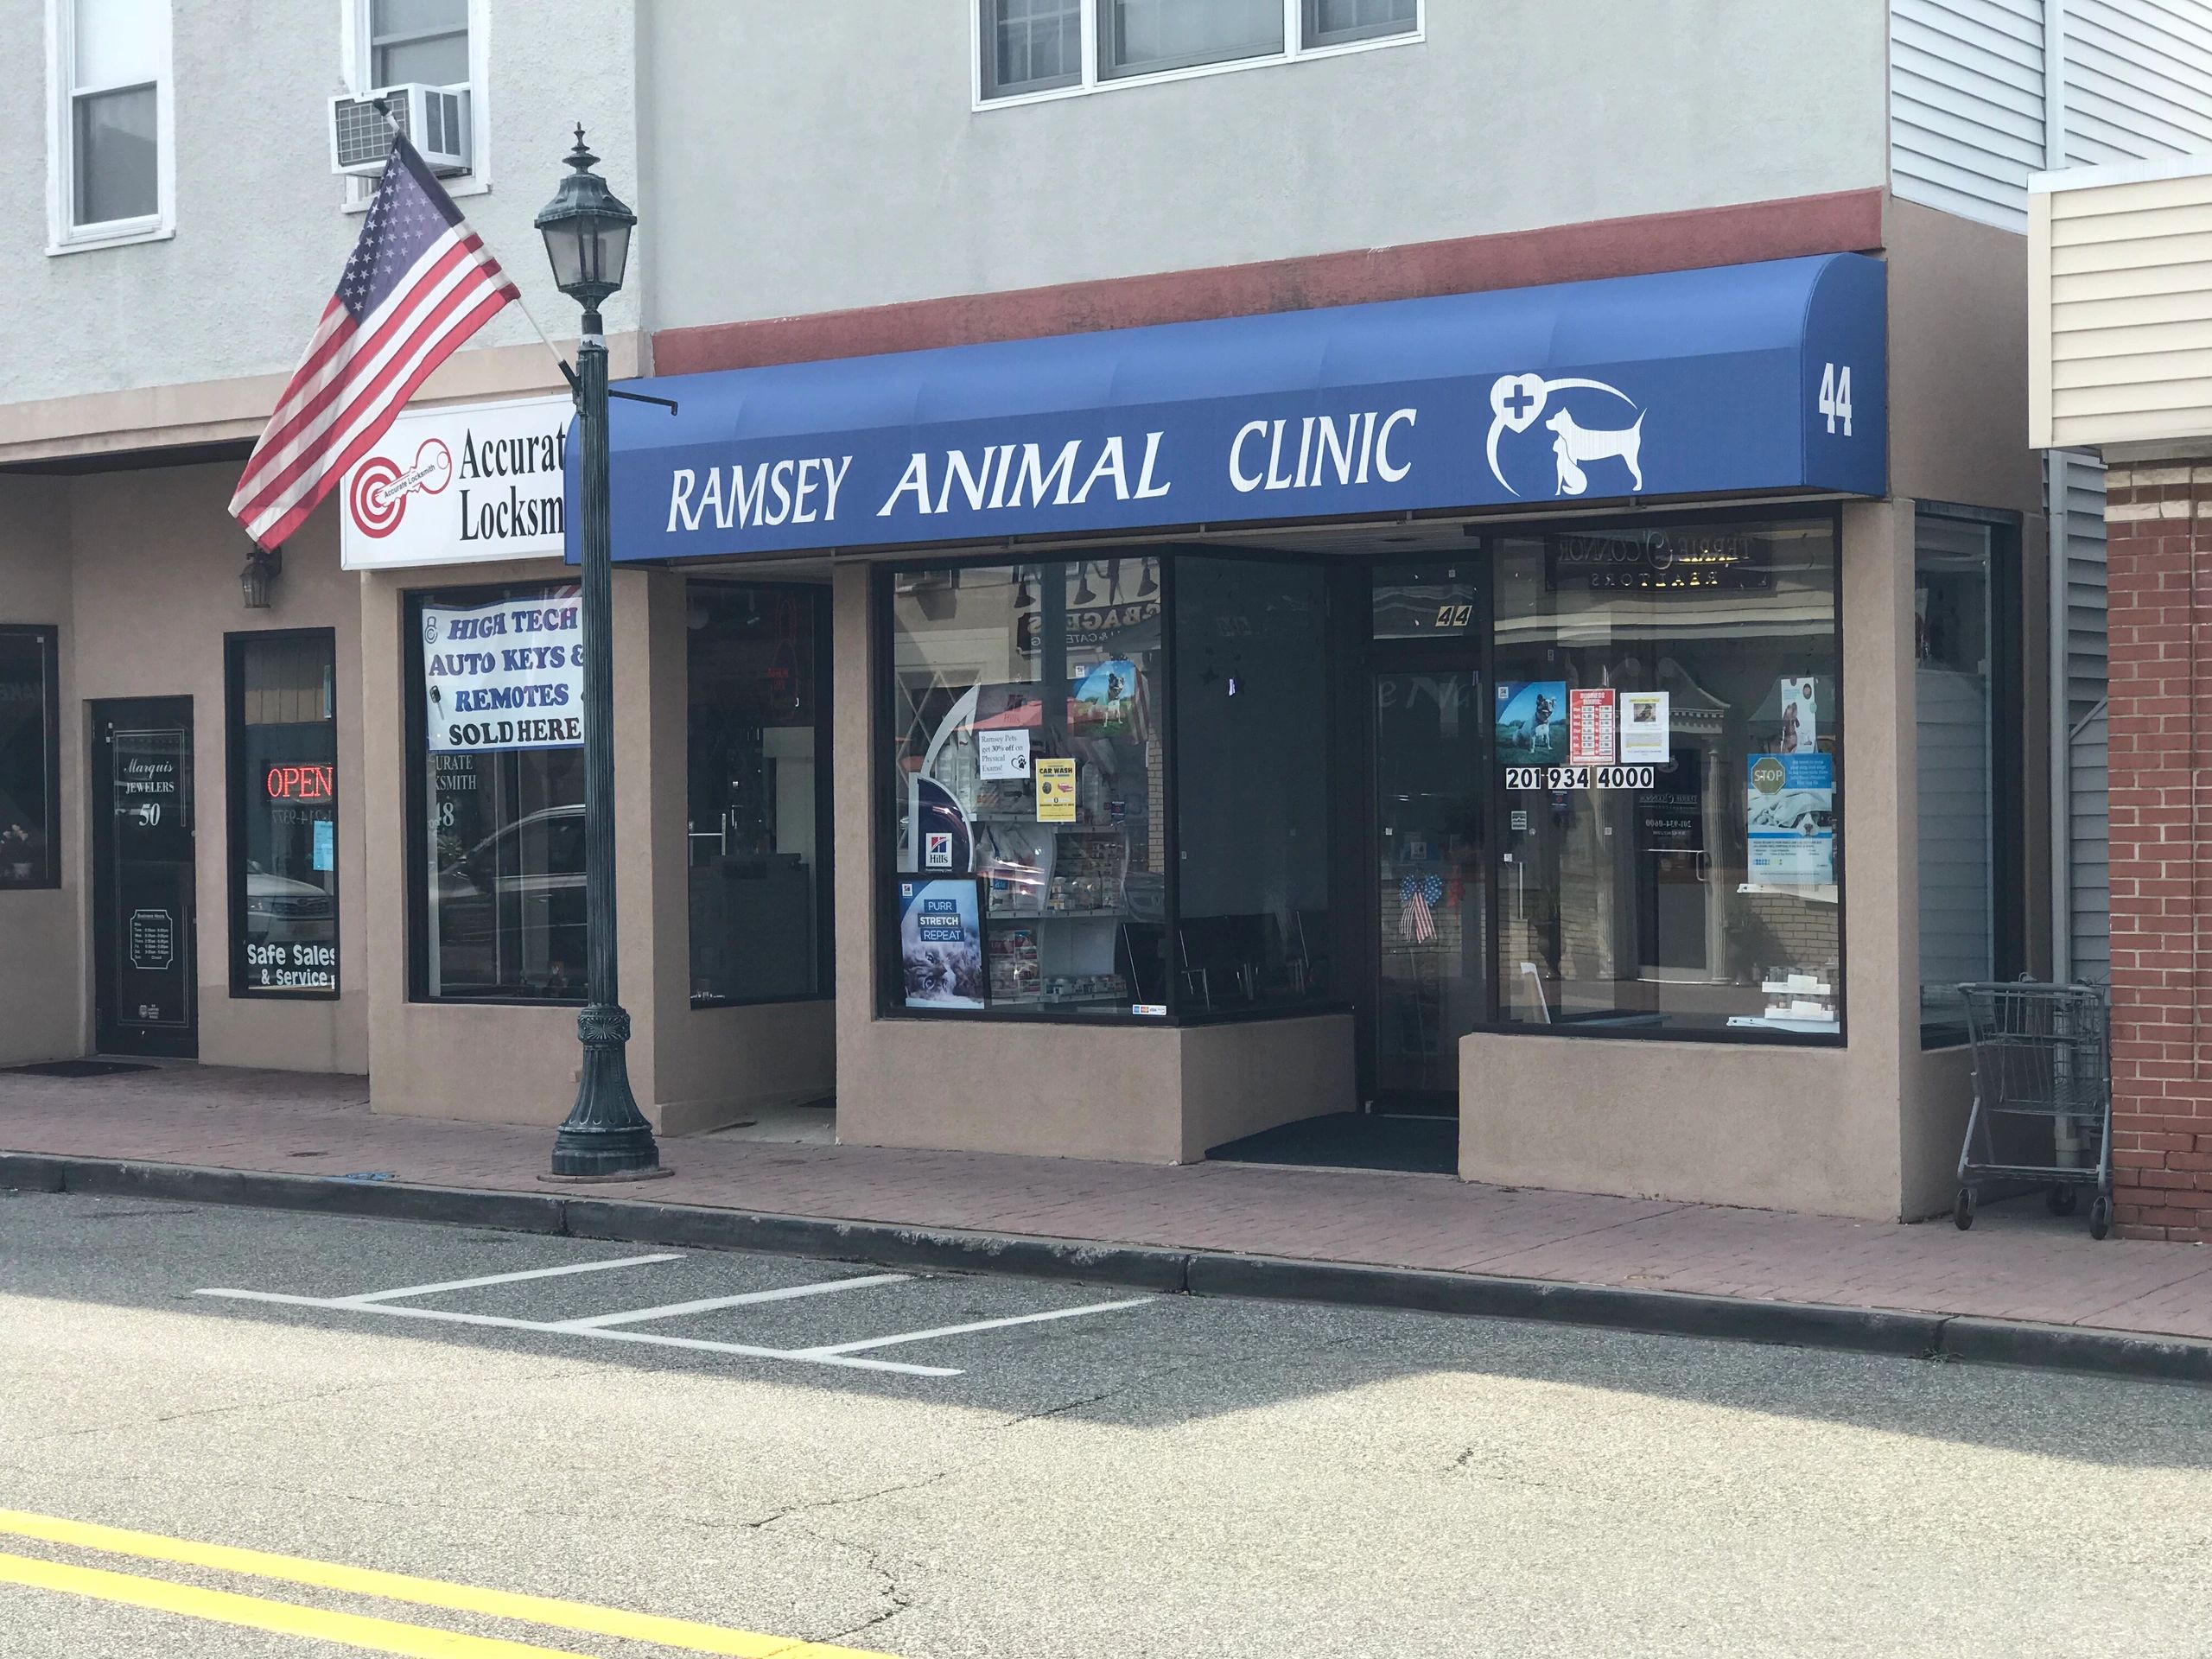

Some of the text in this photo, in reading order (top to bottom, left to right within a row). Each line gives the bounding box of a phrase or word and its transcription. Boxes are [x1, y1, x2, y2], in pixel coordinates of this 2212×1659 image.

[1818, 362, 1853, 436] 44
[665, 408, 1418, 532] RAMSEY ANIMAL CLINIC
[384, 464, 435, 499] Accurate Locksmith
[447, 607, 578, 640] HIGH TECH
[1437, 606, 1470, 625] 44
[429, 652, 496, 676] AUTO
[501, 646, 565, 671] KEYS
[455, 683, 569, 712] REMOTES
[448, 717, 582, 746] SOLD HERE
[982, 735, 1003, 744] Ramsey
[982, 746, 990, 754] get
[124, 758, 173, 779] Marquis
[1507, 767, 1653, 788] 201 934 4000
[1754, 769, 1783, 781] STOP
[125, 781, 175, 794] JEWELERS
[267, 766, 333, 798] OPEN
[138, 803, 160, 826] 50
[930, 854, 949, 864] Hill's
[928, 901, 952, 911] PURR
[919, 916, 958, 925] STRETCH
[924, 931, 961, 940] REPEAT
[247, 944, 335, 966] Safe Sales
[261, 968, 328, 986] & Service
